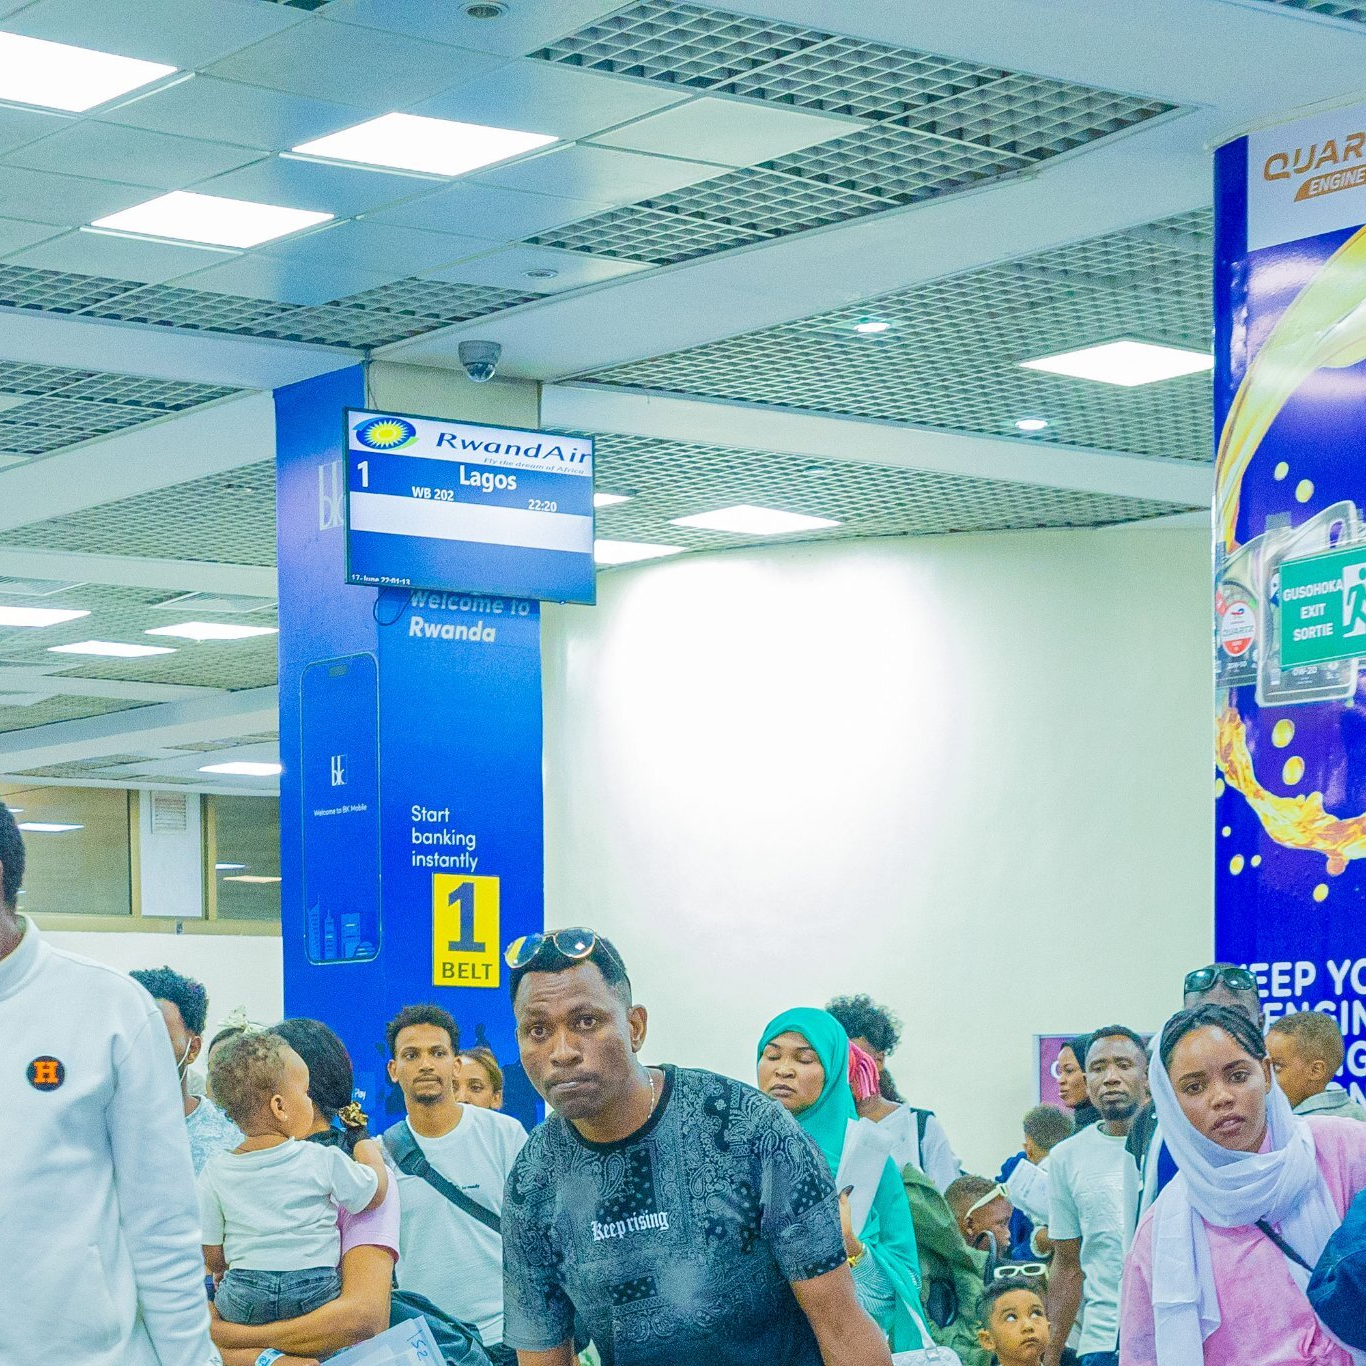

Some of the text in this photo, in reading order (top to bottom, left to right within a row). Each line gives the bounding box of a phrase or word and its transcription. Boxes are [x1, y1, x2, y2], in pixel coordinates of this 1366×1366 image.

[1309, 171, 1366, 195] ENGINE
[436, 432, 592, 464] RwandAir
[357, 460, 517, 492] 1 Lagos
[515, 460, 544, 470] dream
[556, 465, 585, 475] Africa
[411, 485, 454, 502] WB 202
[528, 498, 557, 513] 22:20
[1283, 578, 1343, 601] GUSOHOKA
[410, 590, 530, 616] Welcome to
[1300, 603, 1326, 619] EXIT
[409, 616, 496, 643] Rwanda
[1293, 623, 1334, 641] SORTIE
[411, 805, 450, 823] Start
[411, 828, 476, 850] banking
[411, 851, 479, 872] instantly
[447, 882, 486, 953] 1
[441, 962, 493, 981] BELT
[1239, 959, 1317, 997] EEP
[33, 1060, 59, 1083] H
[591, 1209, 669, 1241] Keep rising
